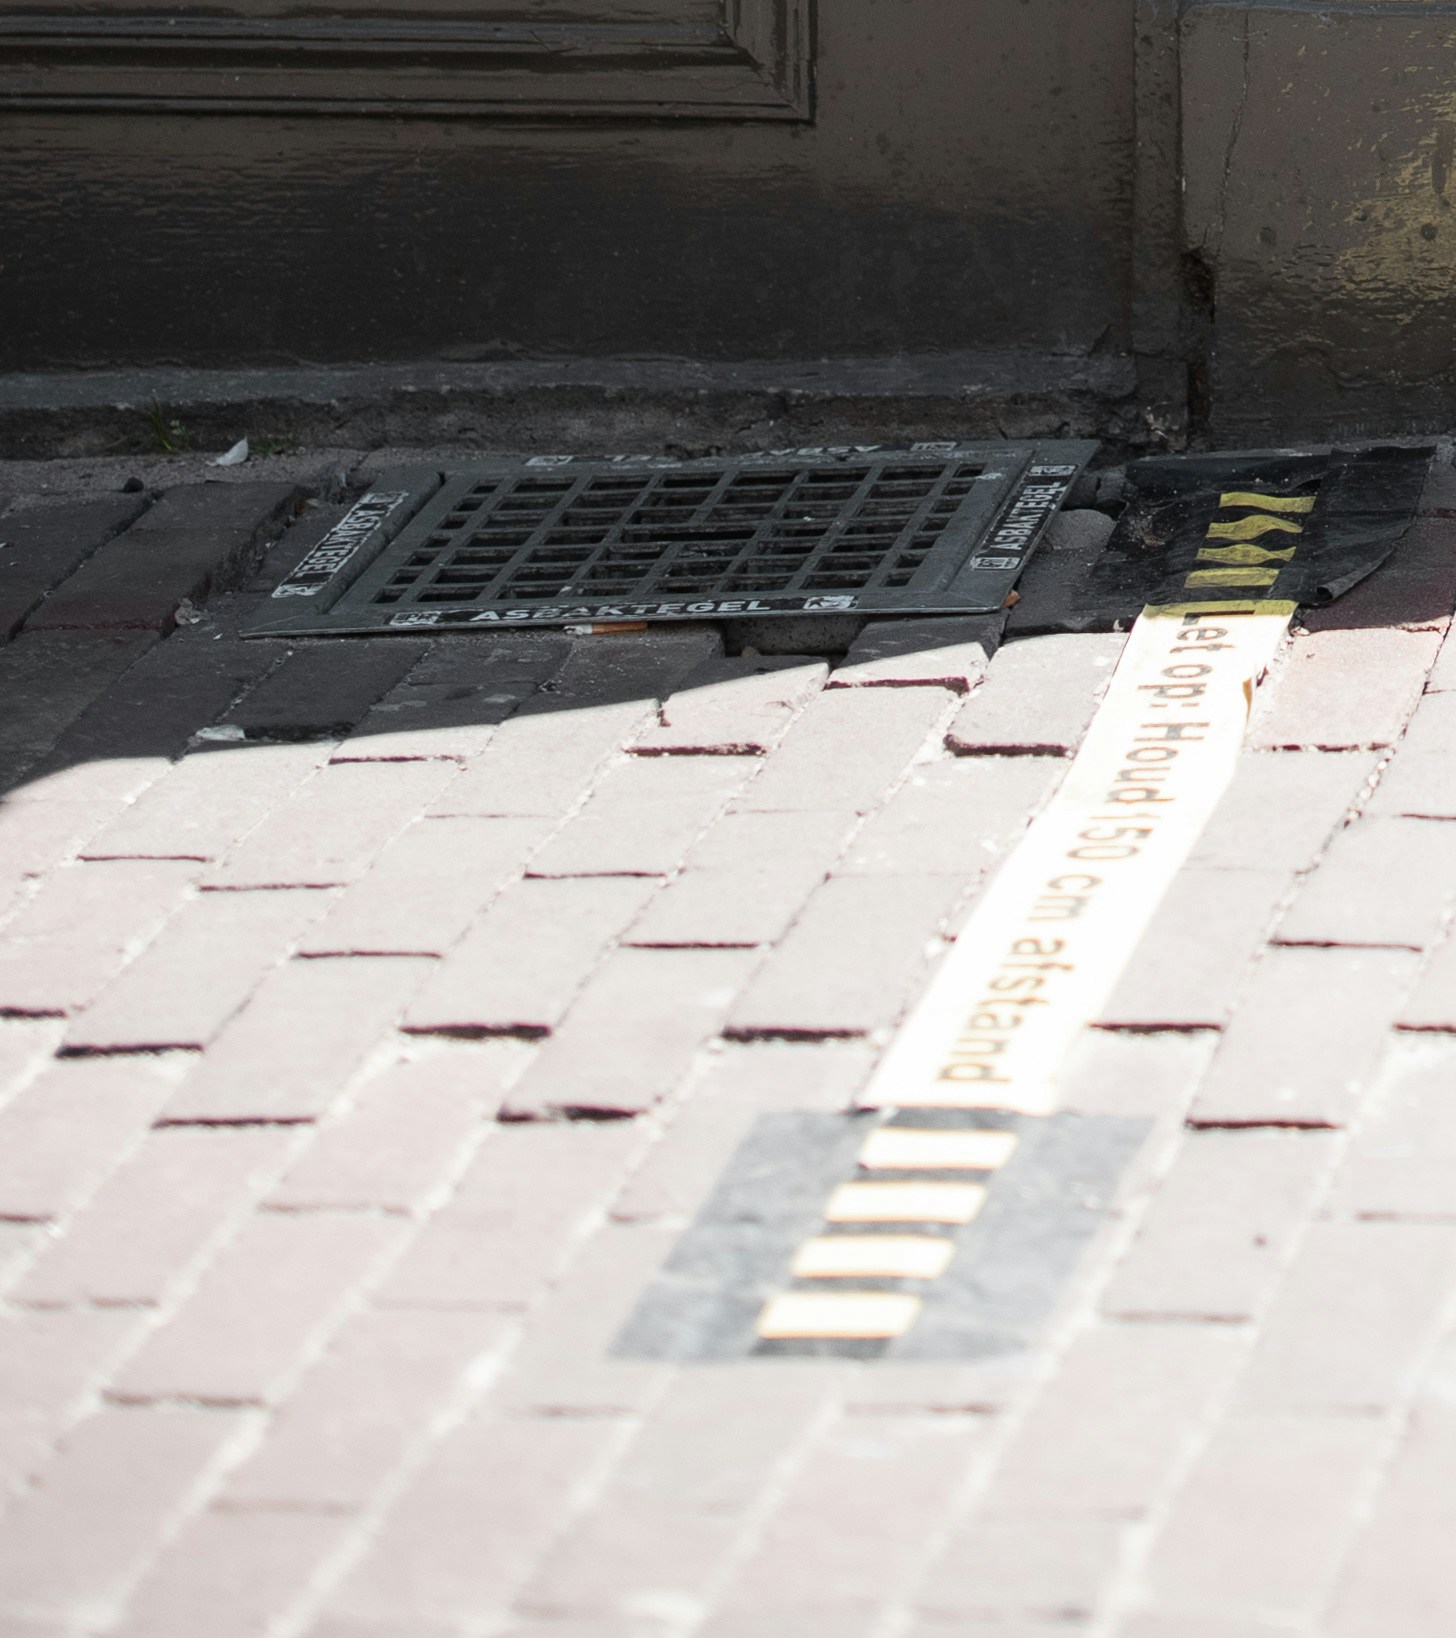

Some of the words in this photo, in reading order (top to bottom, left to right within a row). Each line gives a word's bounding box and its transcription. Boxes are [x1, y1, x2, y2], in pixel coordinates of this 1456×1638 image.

[989, 481, 1062, 550] ASBAKTEGEL
[470, 599, 772, 623] ASBAKTEGEL
[1168, 609, 1256, 654] Let
[1137, 662, 1214, 708] op:
[1104, 721, 1211, 804] Houd
[1065, 812, 1163, 861] 150
[1026, 873, 1104, 922] cm
[935, 937, 1076, 1084] afstand
